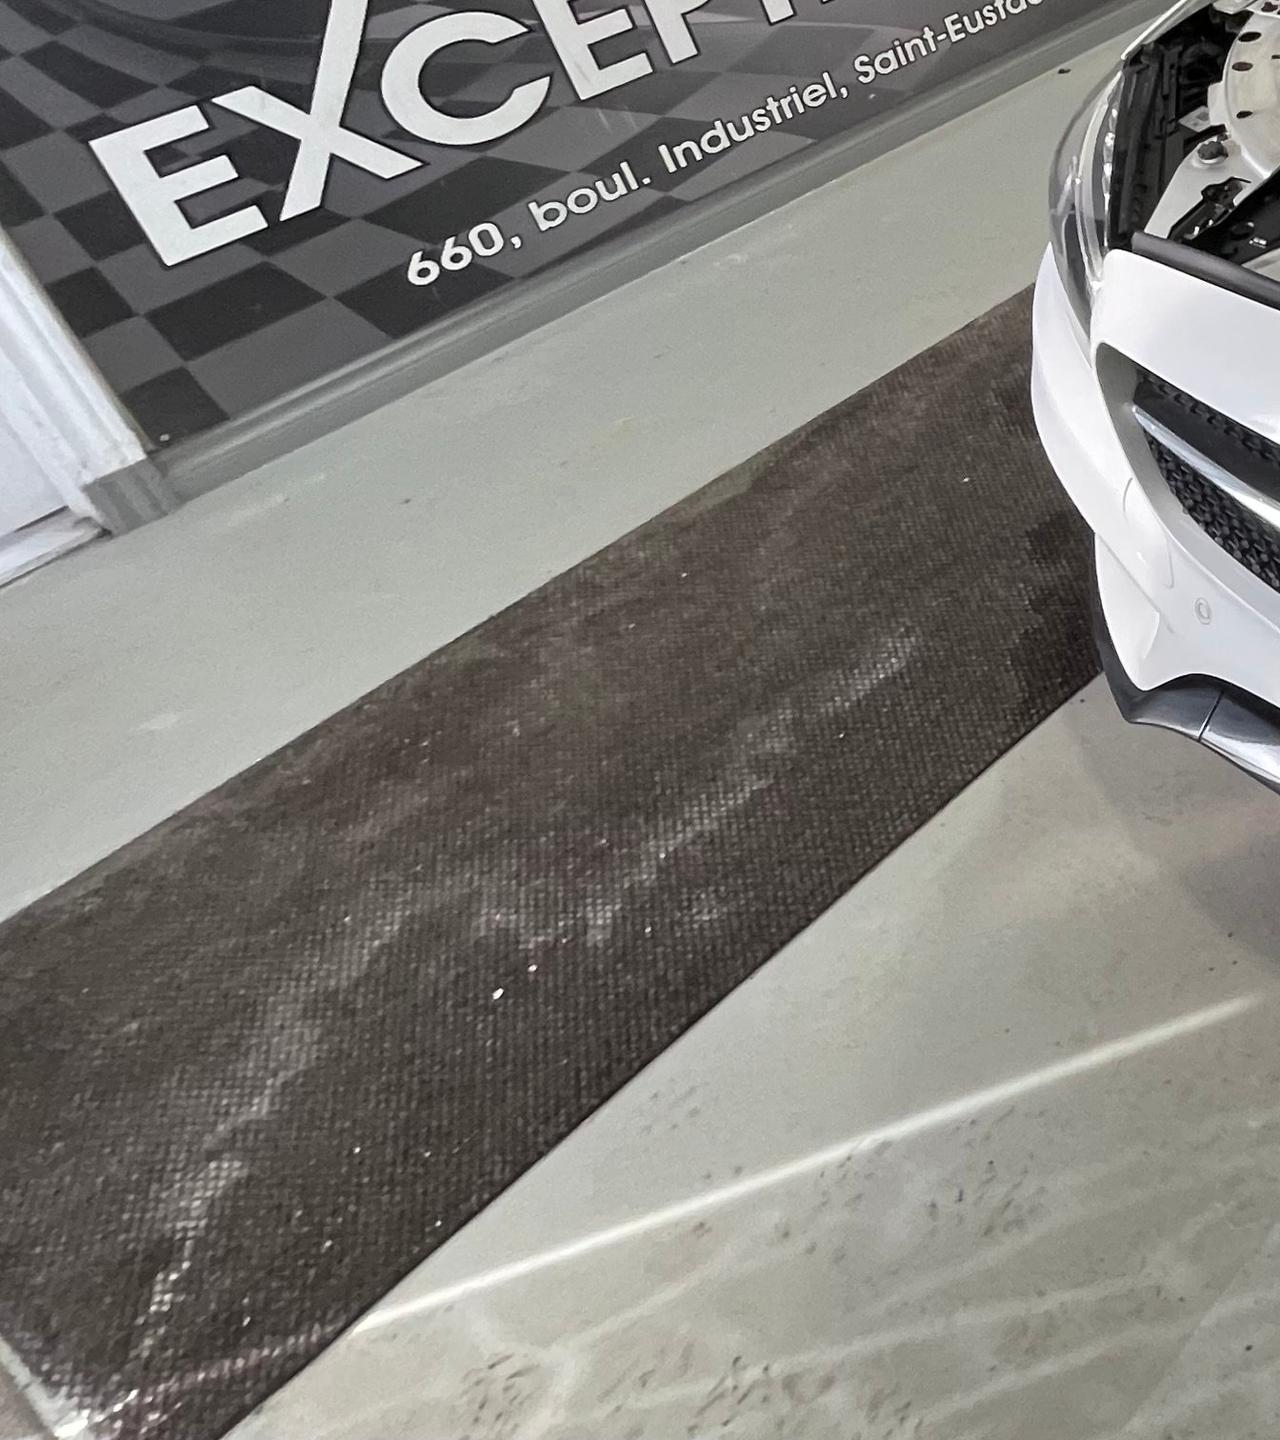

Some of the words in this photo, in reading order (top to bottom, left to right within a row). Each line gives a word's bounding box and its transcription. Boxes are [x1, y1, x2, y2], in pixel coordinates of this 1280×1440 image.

[407, 221, 522, 286] 660,
[528, 161, 651, 232] boul.
[658, 71, 849, 174] Industriel,
